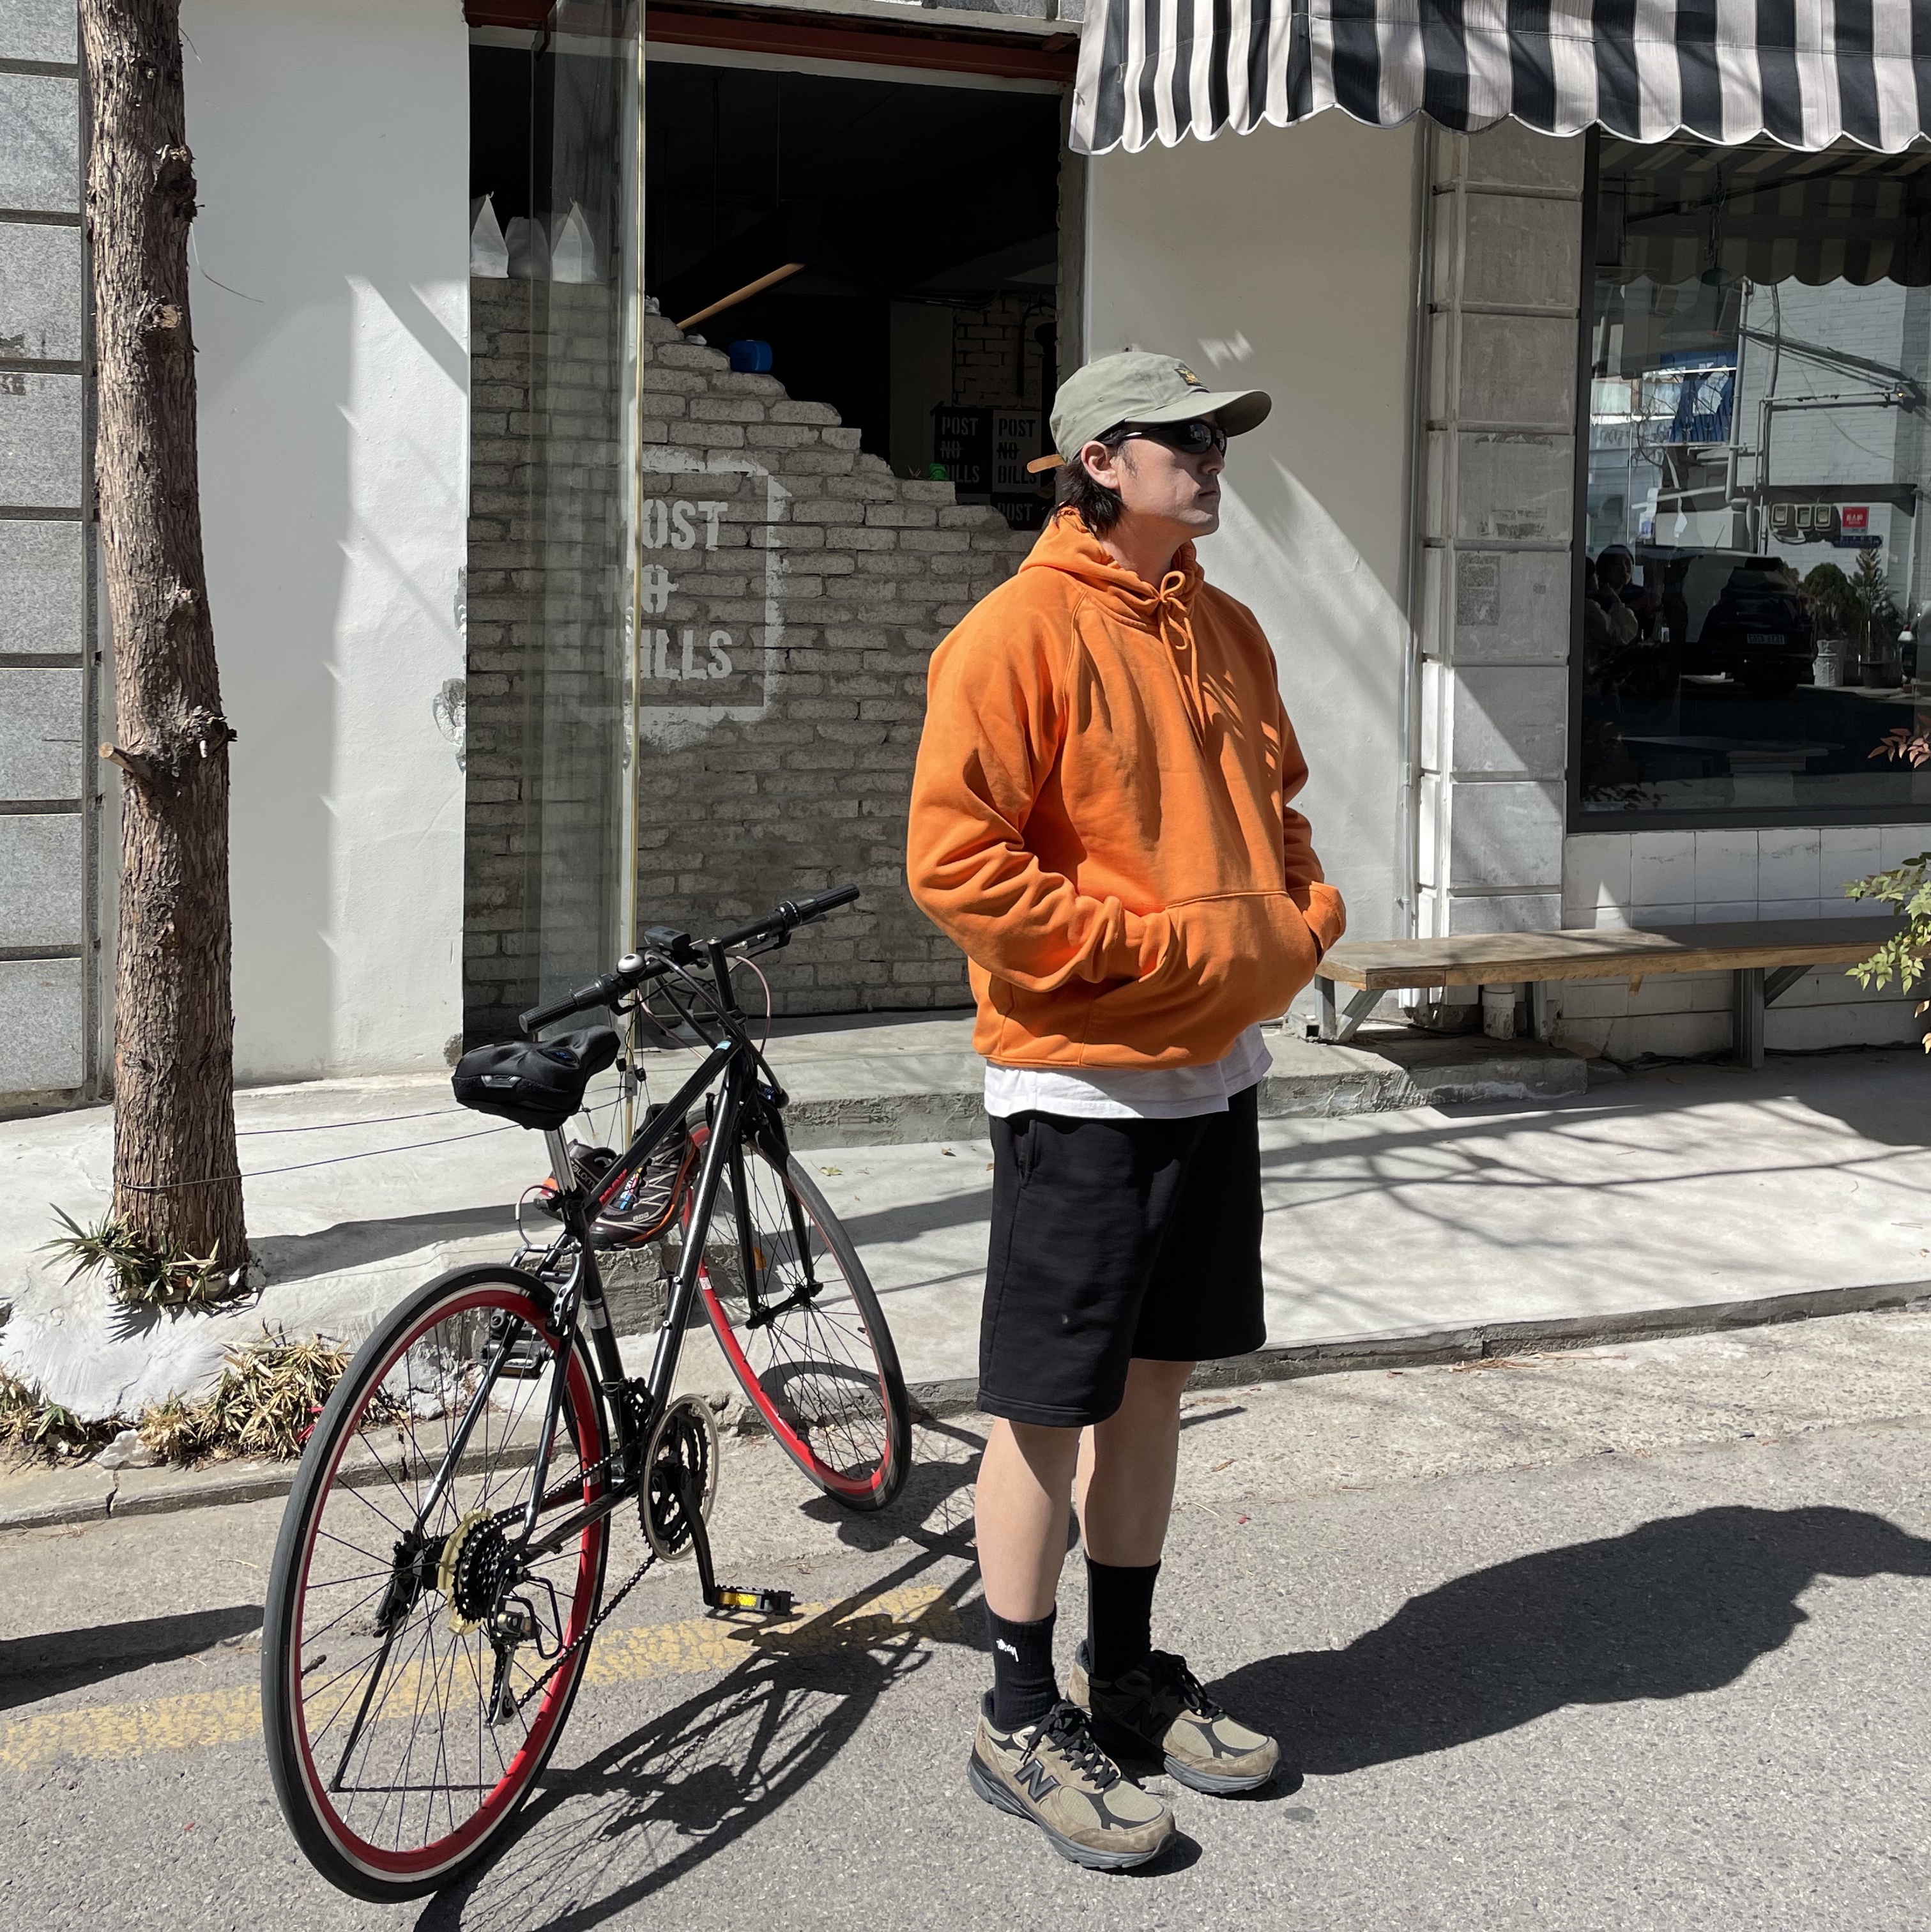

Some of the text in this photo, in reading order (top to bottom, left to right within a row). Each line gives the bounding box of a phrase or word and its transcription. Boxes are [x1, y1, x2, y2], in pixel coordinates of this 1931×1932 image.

[942, 417, 978, 436] POST
[998, 418, 1035, 437] POST
[997, 442, 1020, 460] NO
[1014, 1758, 1061, 1803] N
